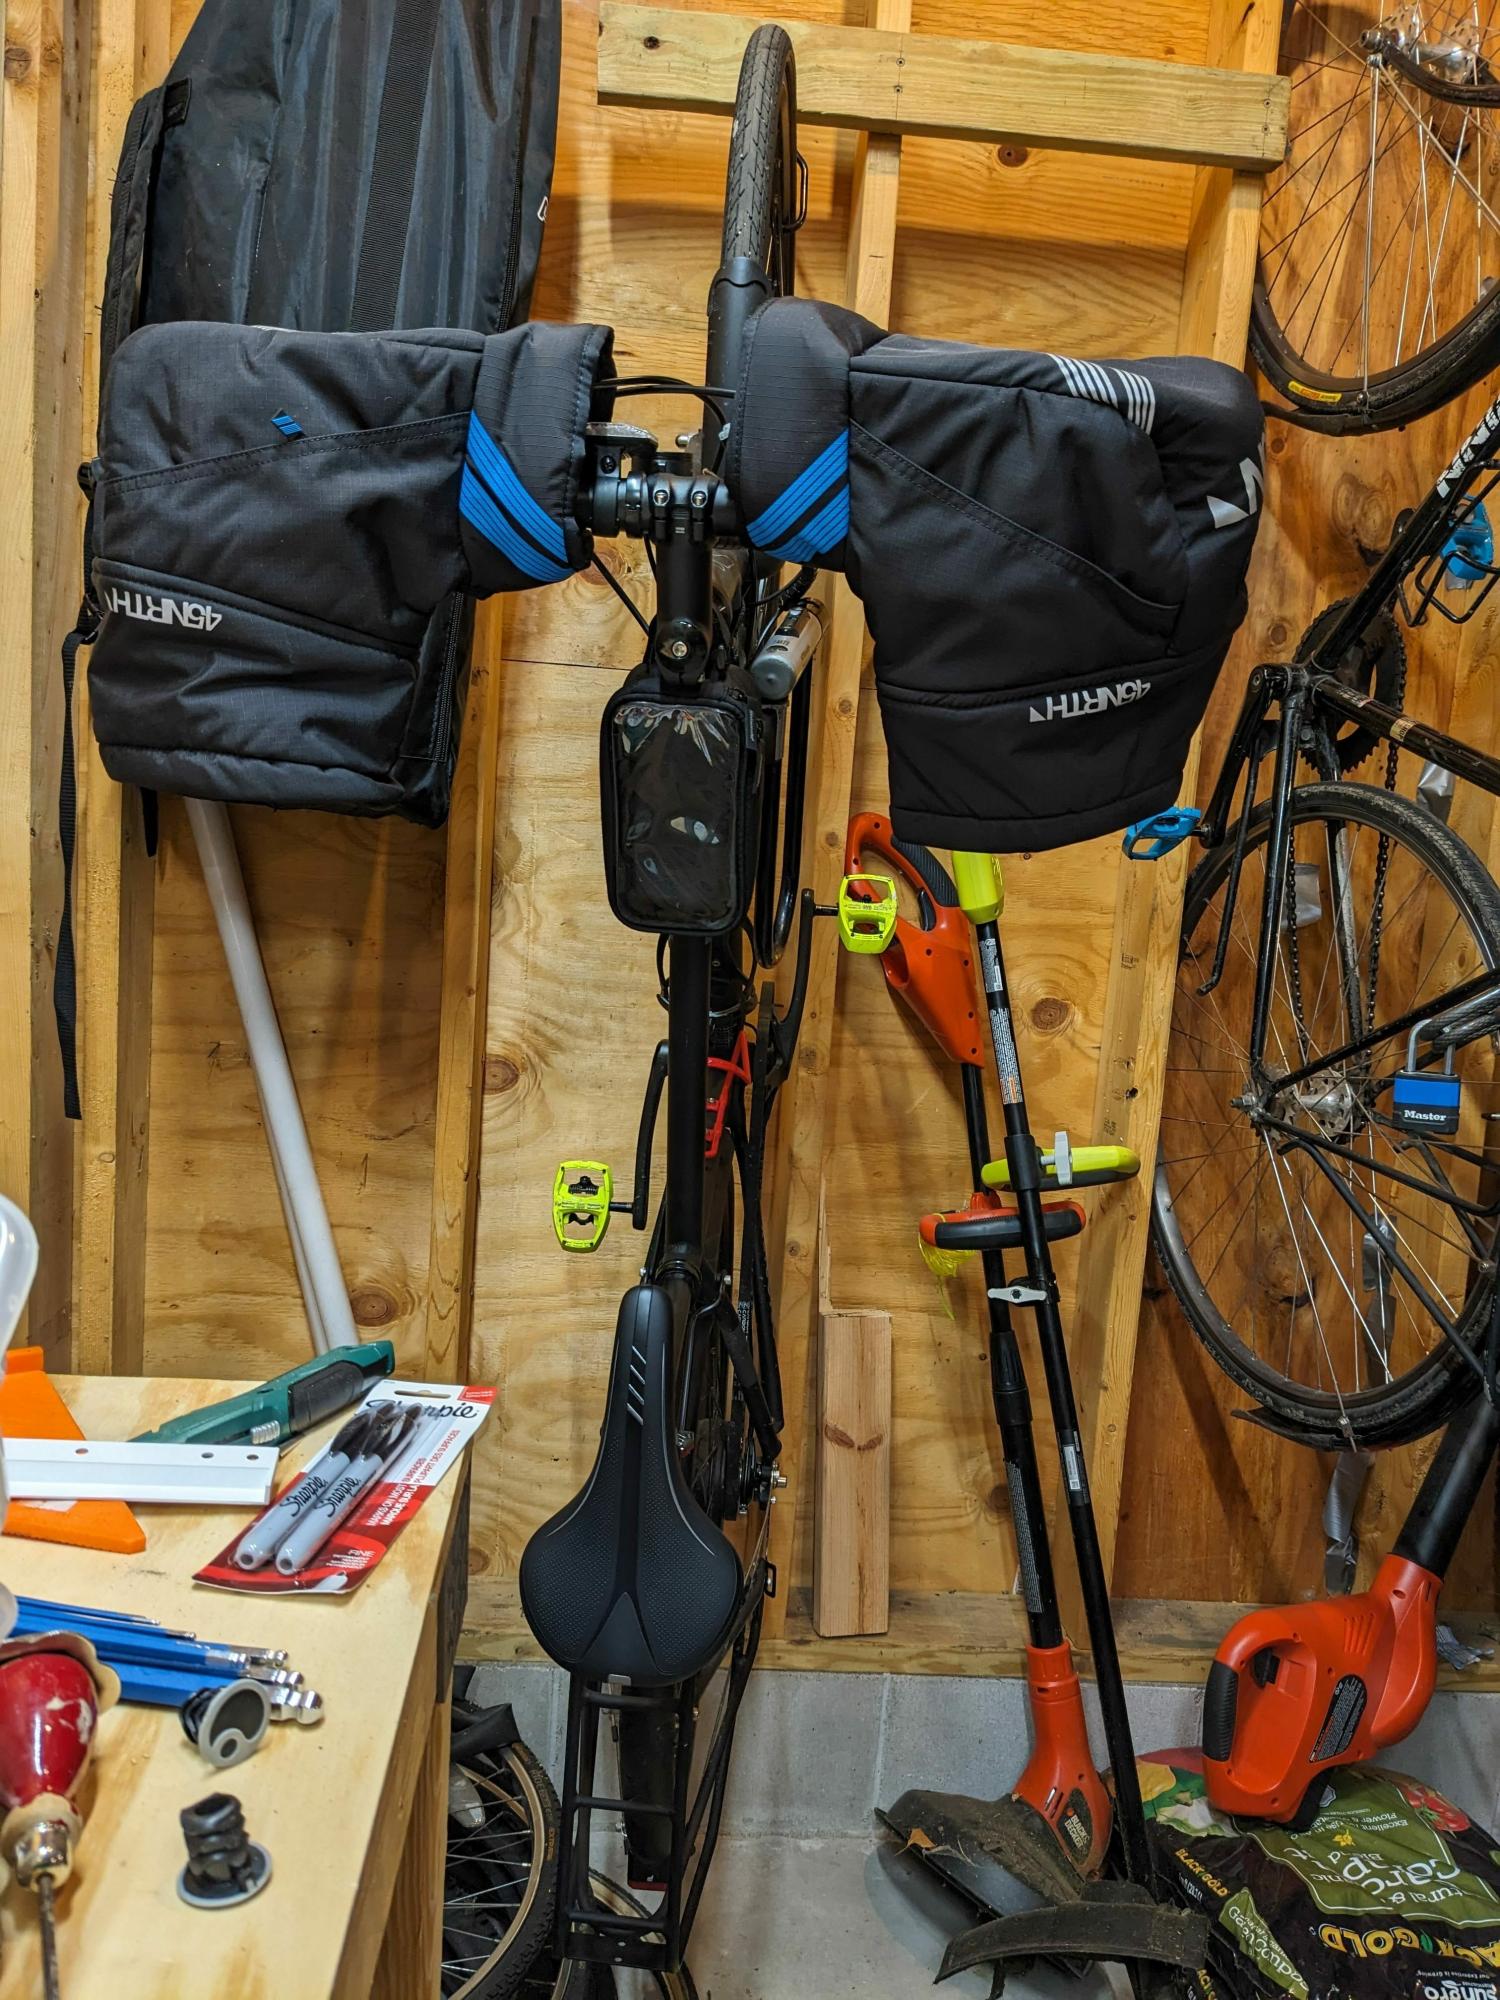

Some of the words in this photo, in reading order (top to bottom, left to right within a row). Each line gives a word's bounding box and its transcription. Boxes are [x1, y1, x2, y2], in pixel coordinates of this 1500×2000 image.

[111, 587, 223, 632] 45NRTH
[1046, 679, 1151, 721] 45NRTH
[1404, 1109, 1447, 1122] Master
[281, 1475, 328, 1517] Sharpie
[314, 1476, 360, 1518] Sharpie
[1362, 1819, 1409, 1832] Excellent
[1175, 1848, 1205, 1875] BLACK
[1202, 1873, 1229, 1897] GOLD
[1319, 1923, 1420, 1958] GOLD
